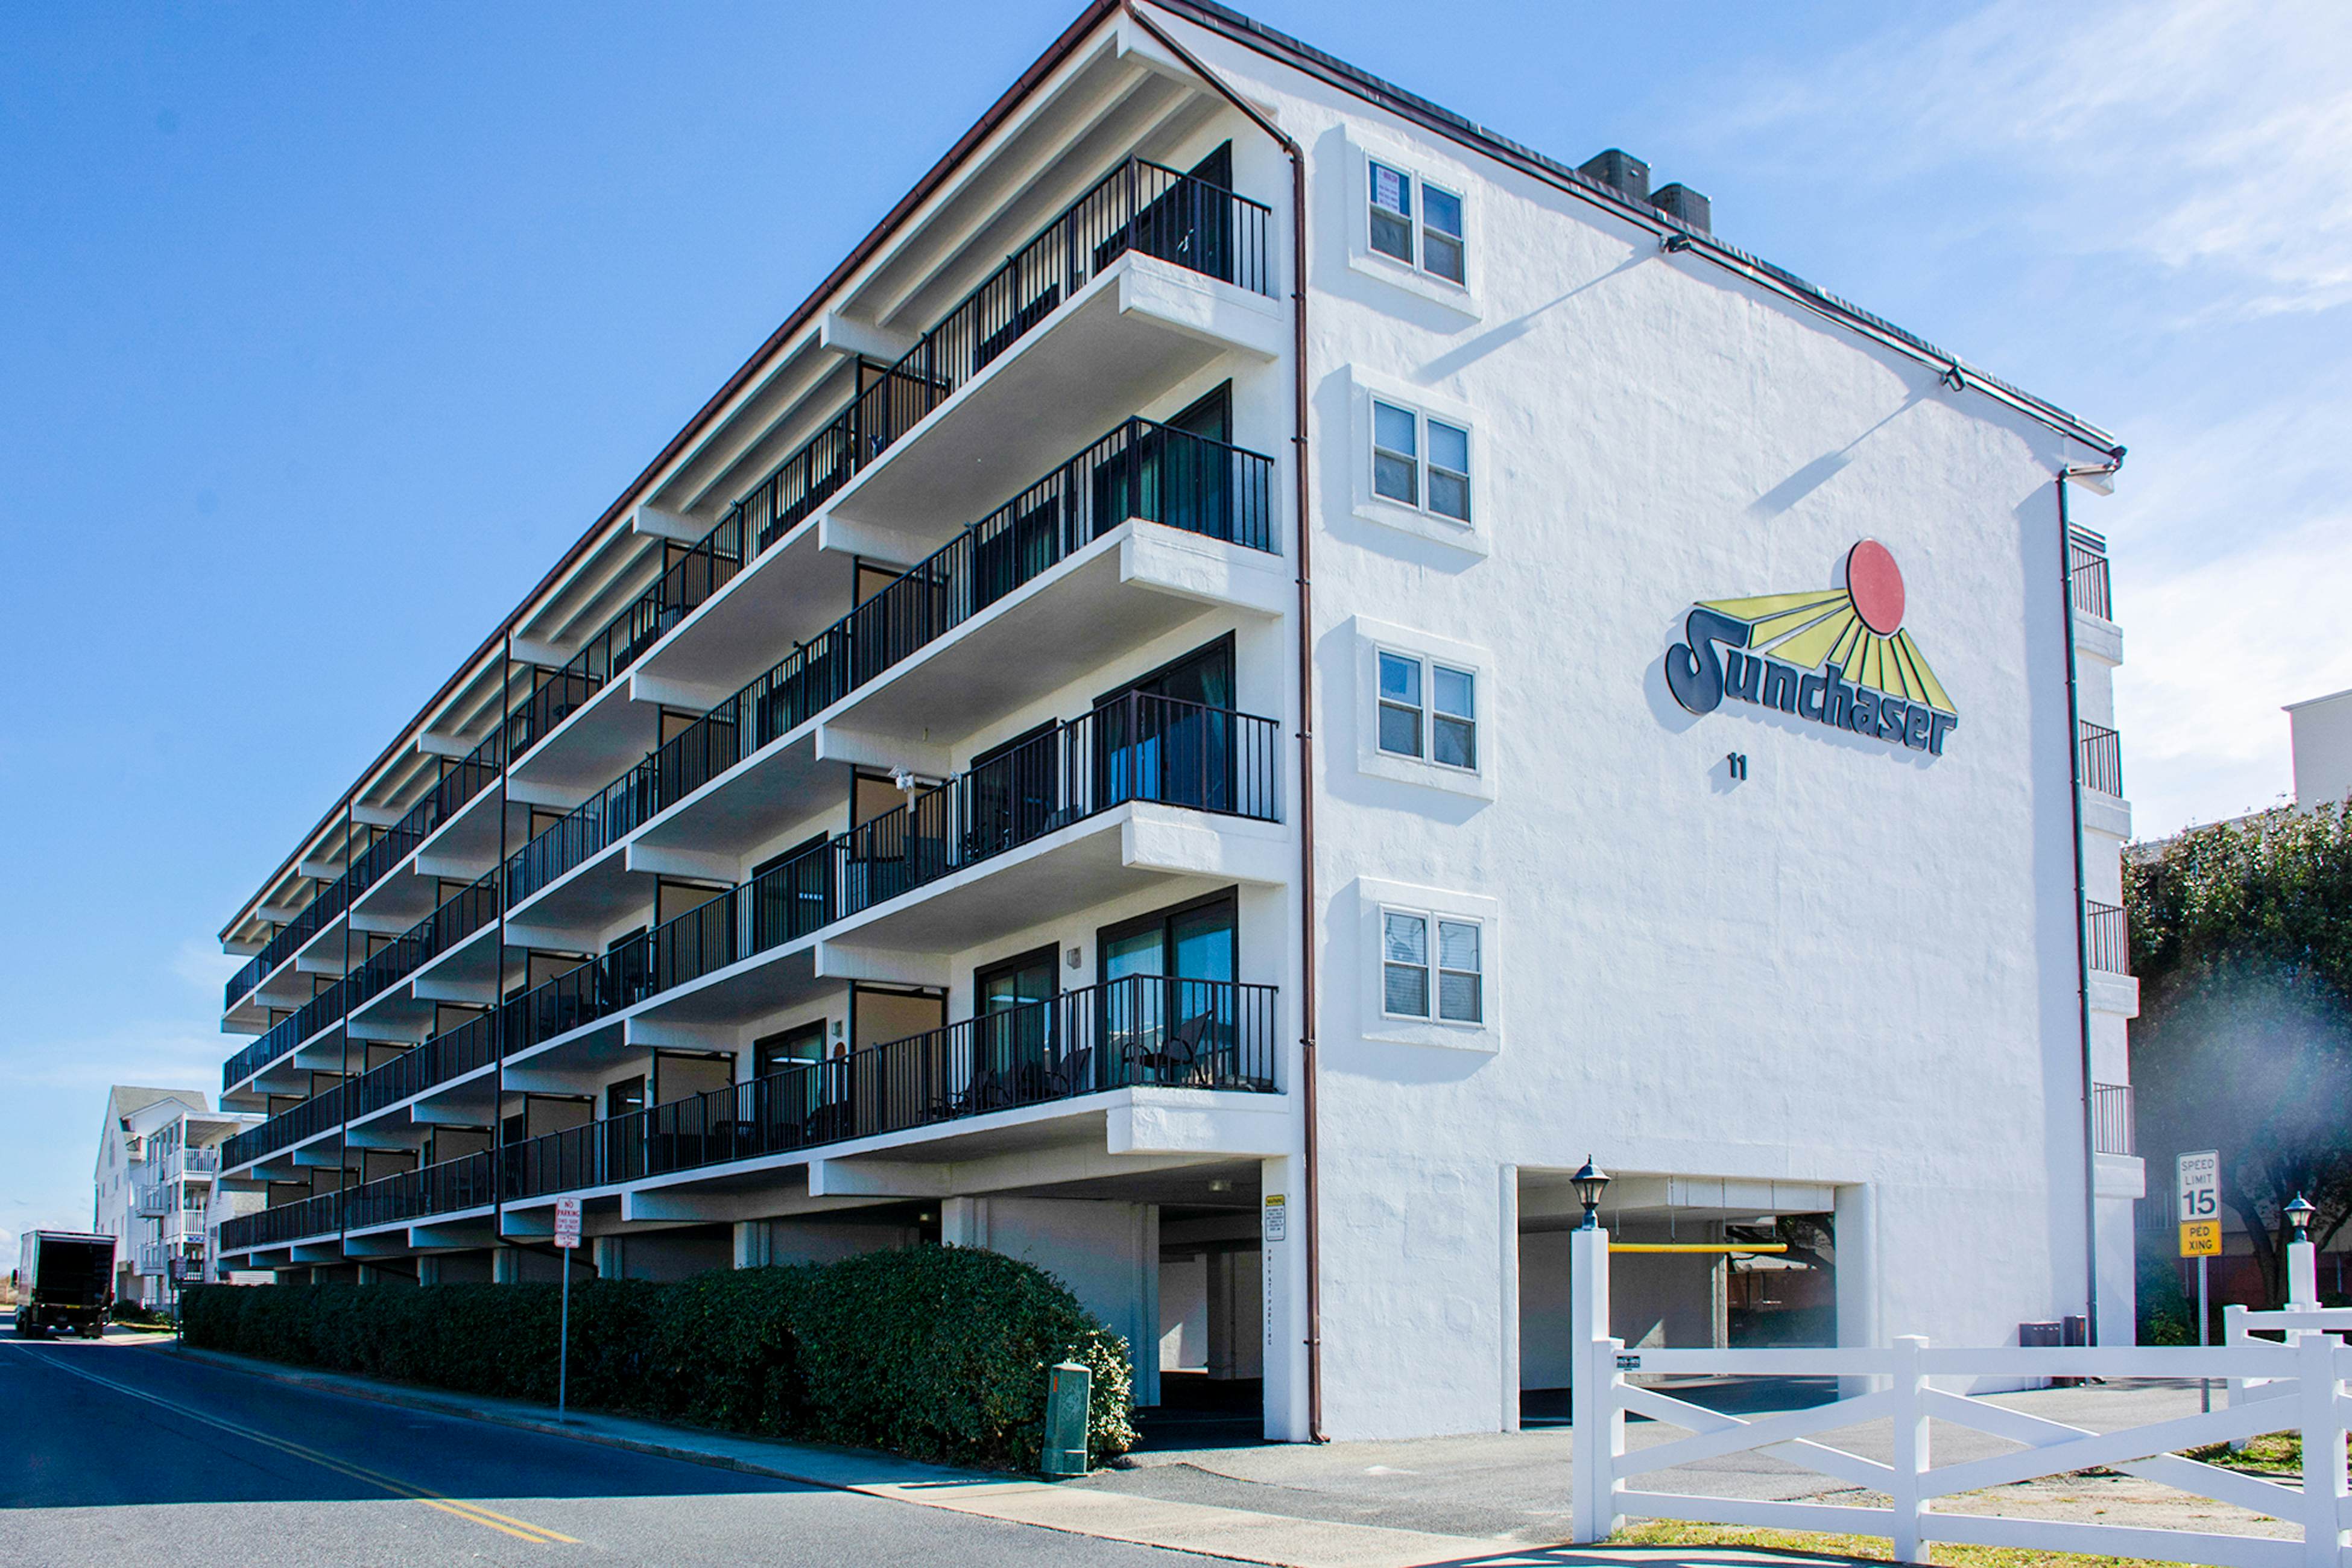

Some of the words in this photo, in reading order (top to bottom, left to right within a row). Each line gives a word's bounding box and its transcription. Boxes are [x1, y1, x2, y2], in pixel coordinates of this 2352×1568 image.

[1666, 608, 1958, 756] Sunchaser
[1727, 752, 1747, 780] 11
[2181, 1159, 2214, 1171] SPEED
[2186, 1174, 2213, 1186] LIMIT
[564, 1200, 574, 1209] NO
[2183, 1189, 2216, 1215] 15
[2190, 1226, 2210, 1237] PED
[2189, 1239, 2213, 1251] XING
